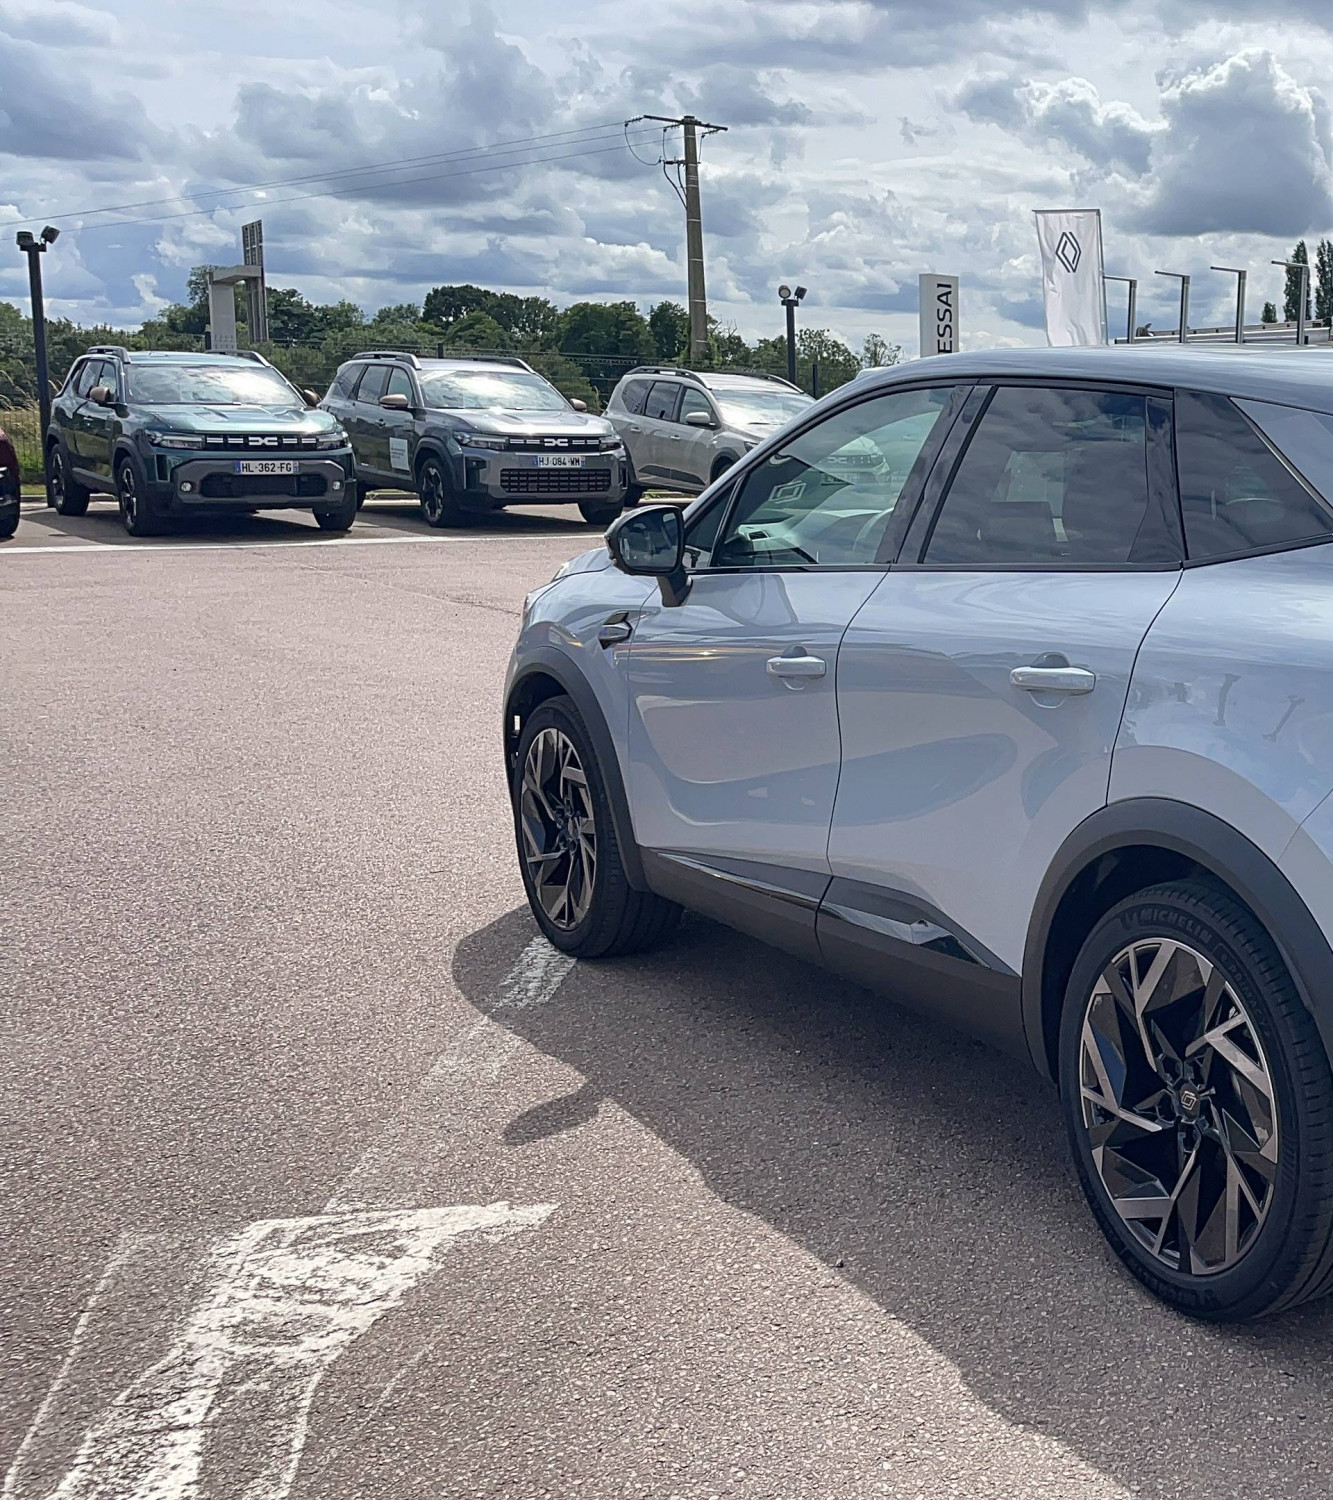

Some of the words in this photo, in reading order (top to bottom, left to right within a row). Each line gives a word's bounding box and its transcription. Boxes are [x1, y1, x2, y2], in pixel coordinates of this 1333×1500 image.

[937, 283, 952, 354] ESSAI
[241, 462, 292, 473] HL-362-FG
[1140, 908, 1213, 944] MICHELIN
